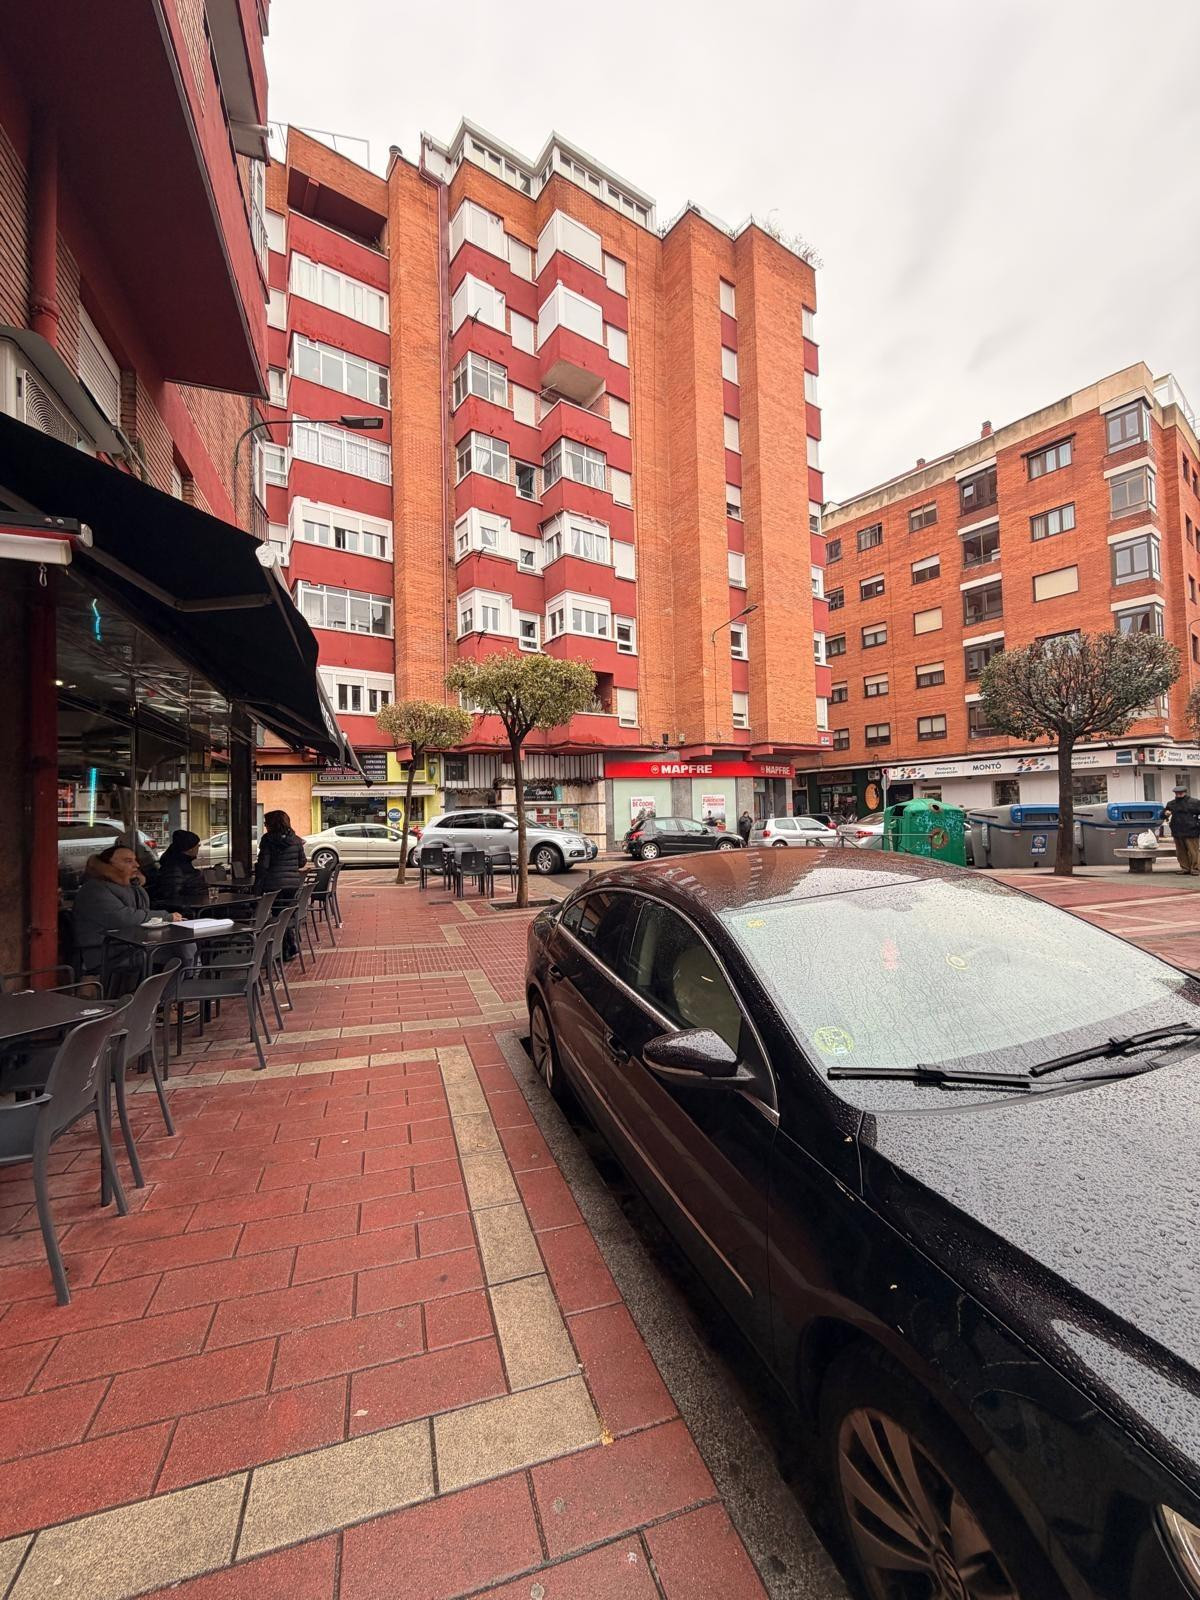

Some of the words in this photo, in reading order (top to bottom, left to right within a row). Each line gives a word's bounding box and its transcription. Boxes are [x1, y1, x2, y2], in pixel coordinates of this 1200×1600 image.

[661, 764, 713, 774] MAPFRE
[765, 765, 790, 775] MAPFRE
[973, 762, 1002, 771] MONTÓ
